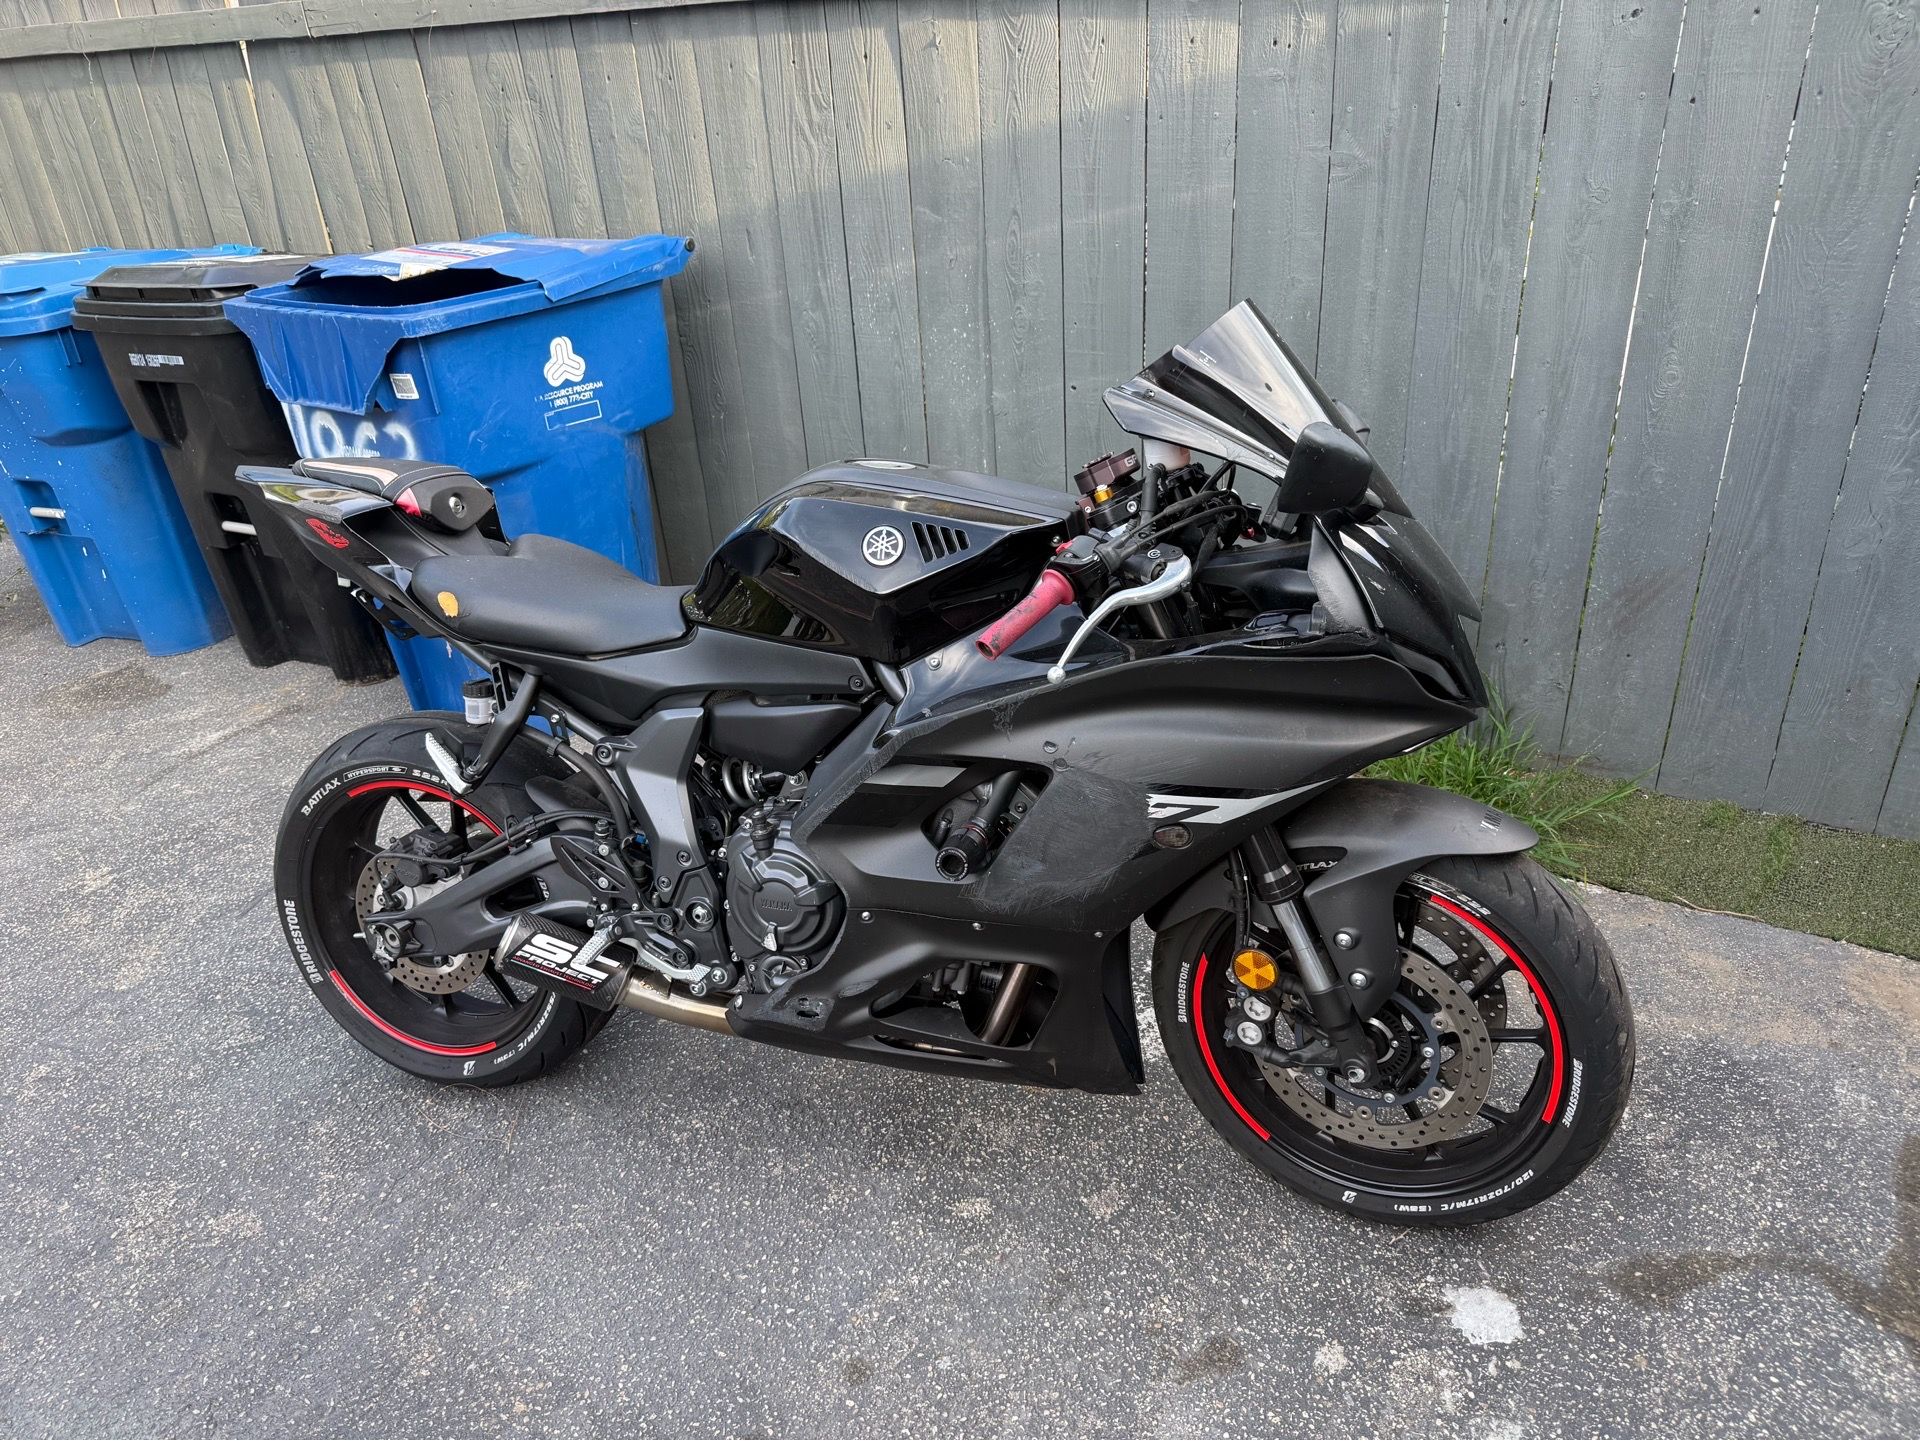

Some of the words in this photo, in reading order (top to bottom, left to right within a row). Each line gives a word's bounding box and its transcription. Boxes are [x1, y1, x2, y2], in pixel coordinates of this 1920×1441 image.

[573, 381, 604, 393] PROGRAM
[301, 777, 342, 816] BATTLAX
[347, 766, 390, 779] HYPERSPORT
[283, 899, 324, 984] BRIDGESTONE
[511, 955, 540, 969] ADVANCED
[515, 950, 603, 984] PROJECT
[1177, 961, 1190, 1023] BRIDGESTONE
[1562, 1057, 1583, 1128] BRIDGESTONE
[1440, 1169, 1534, 1211] 120/70ZR17M/C
